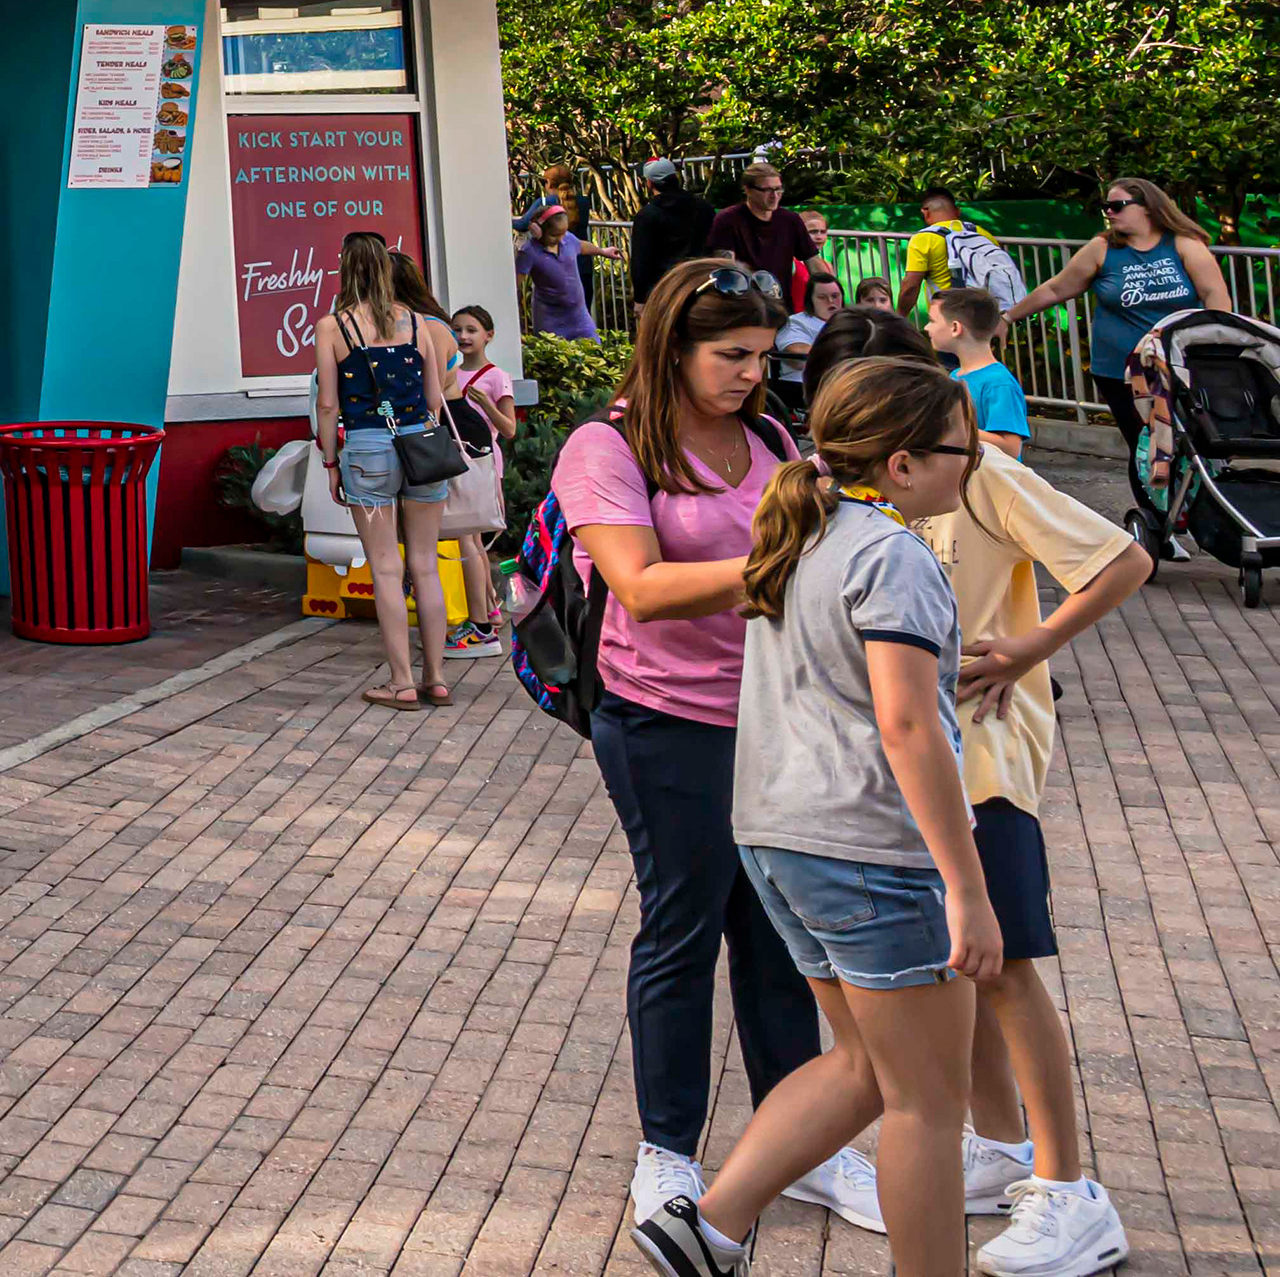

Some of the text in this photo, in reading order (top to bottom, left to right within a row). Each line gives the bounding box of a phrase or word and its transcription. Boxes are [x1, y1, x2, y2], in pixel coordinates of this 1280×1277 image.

[238, 130, 403, 149] KICK START YOUR
[235, 165, 410, 183] AFTERNOON WITH
[266, 200, 383, 218] ONE OF OUR
[1122, 274, 1183, 290] AND A LITTLE
[1120, 285, 1189, 308] Dramatic
